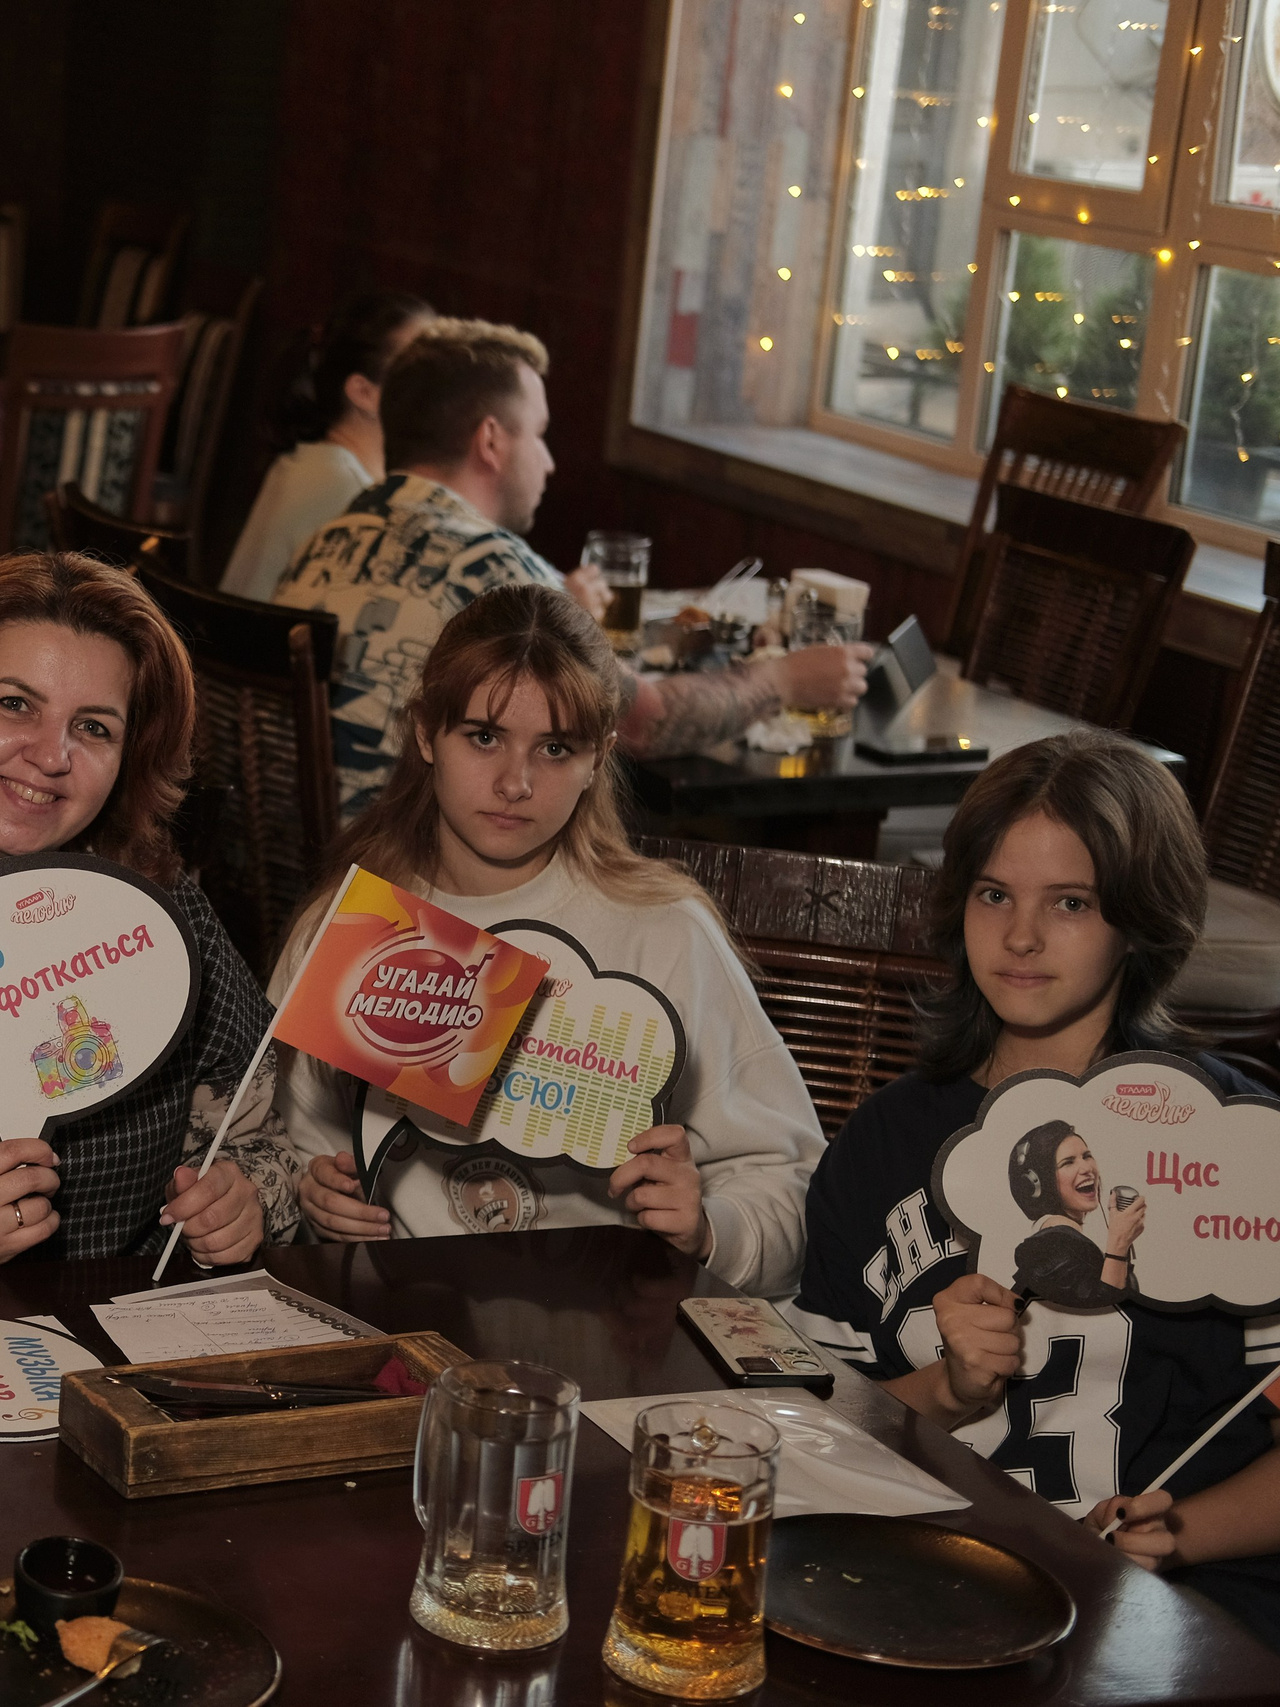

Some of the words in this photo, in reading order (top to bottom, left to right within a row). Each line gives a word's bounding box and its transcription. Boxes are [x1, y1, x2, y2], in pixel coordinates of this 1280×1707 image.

[375, 966, 477, 1000] УГАДАЙ
[348, 993, 481, 1029] МЕЛОДИЮ
[1145, 1150, 1220, 1195] Щас
[1193, 1213, 1280, 1243] спою
[3, 1336, 61, 1402] МУЗЫКА
